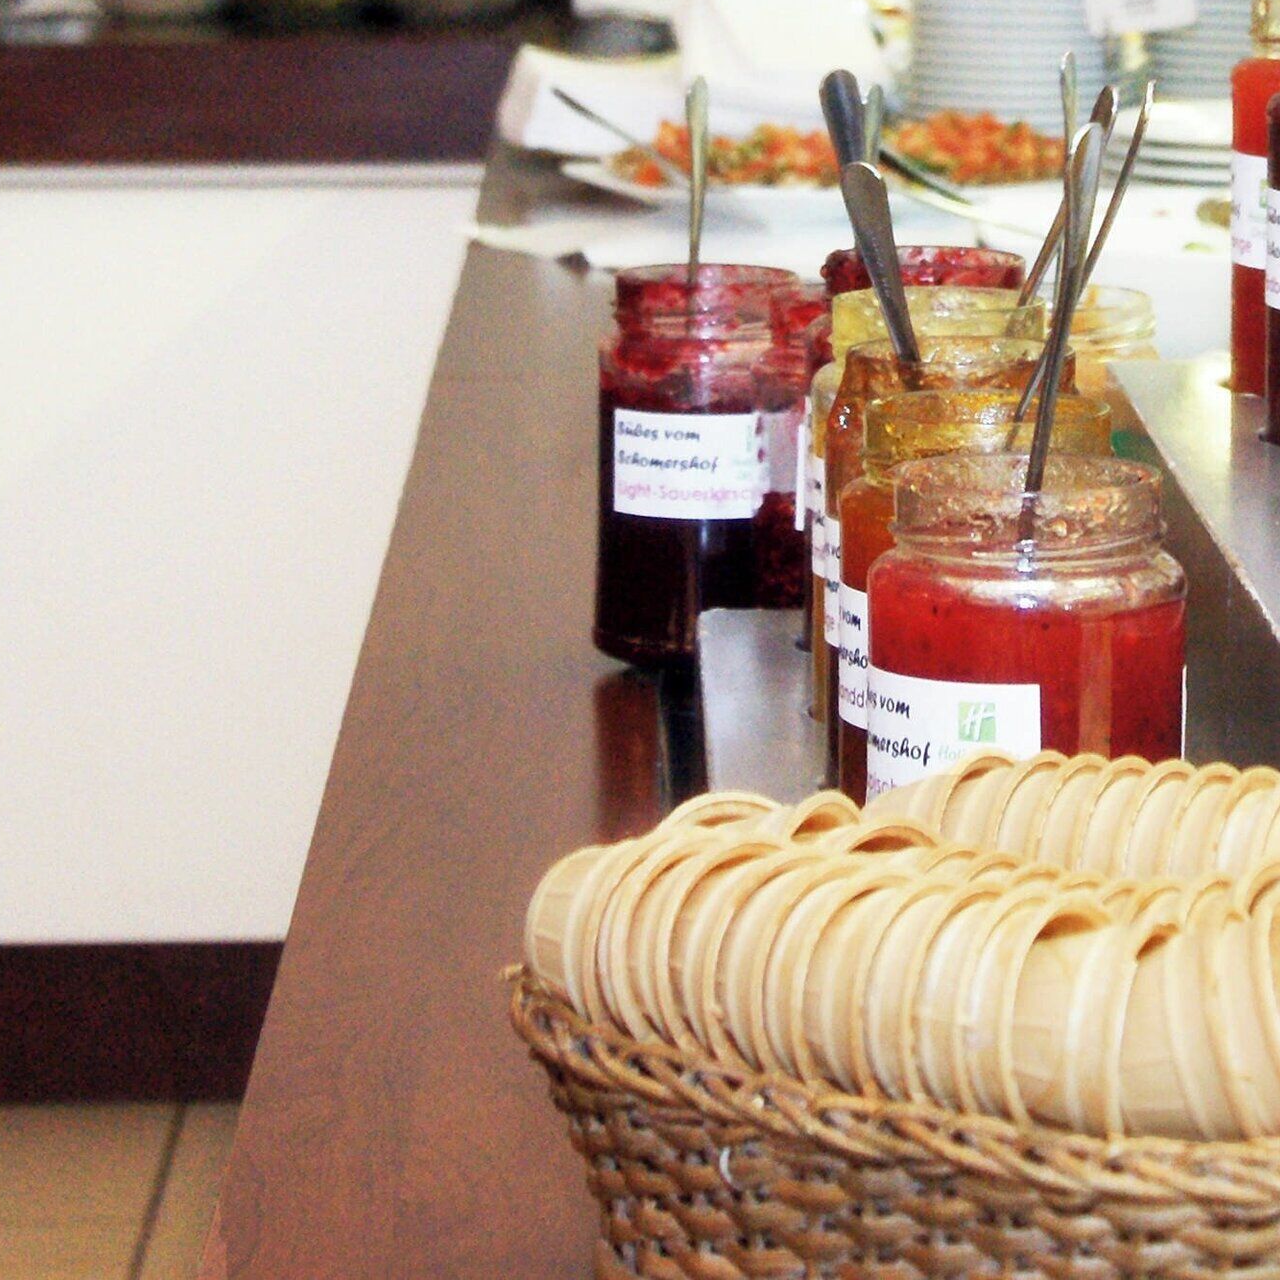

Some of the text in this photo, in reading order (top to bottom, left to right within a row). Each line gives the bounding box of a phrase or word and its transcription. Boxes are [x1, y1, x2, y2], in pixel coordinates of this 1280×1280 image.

[664, 427, 700, 442] vom
[617, 448, 719, 473] Schomershof
[880, 695, 910, 719] vom
